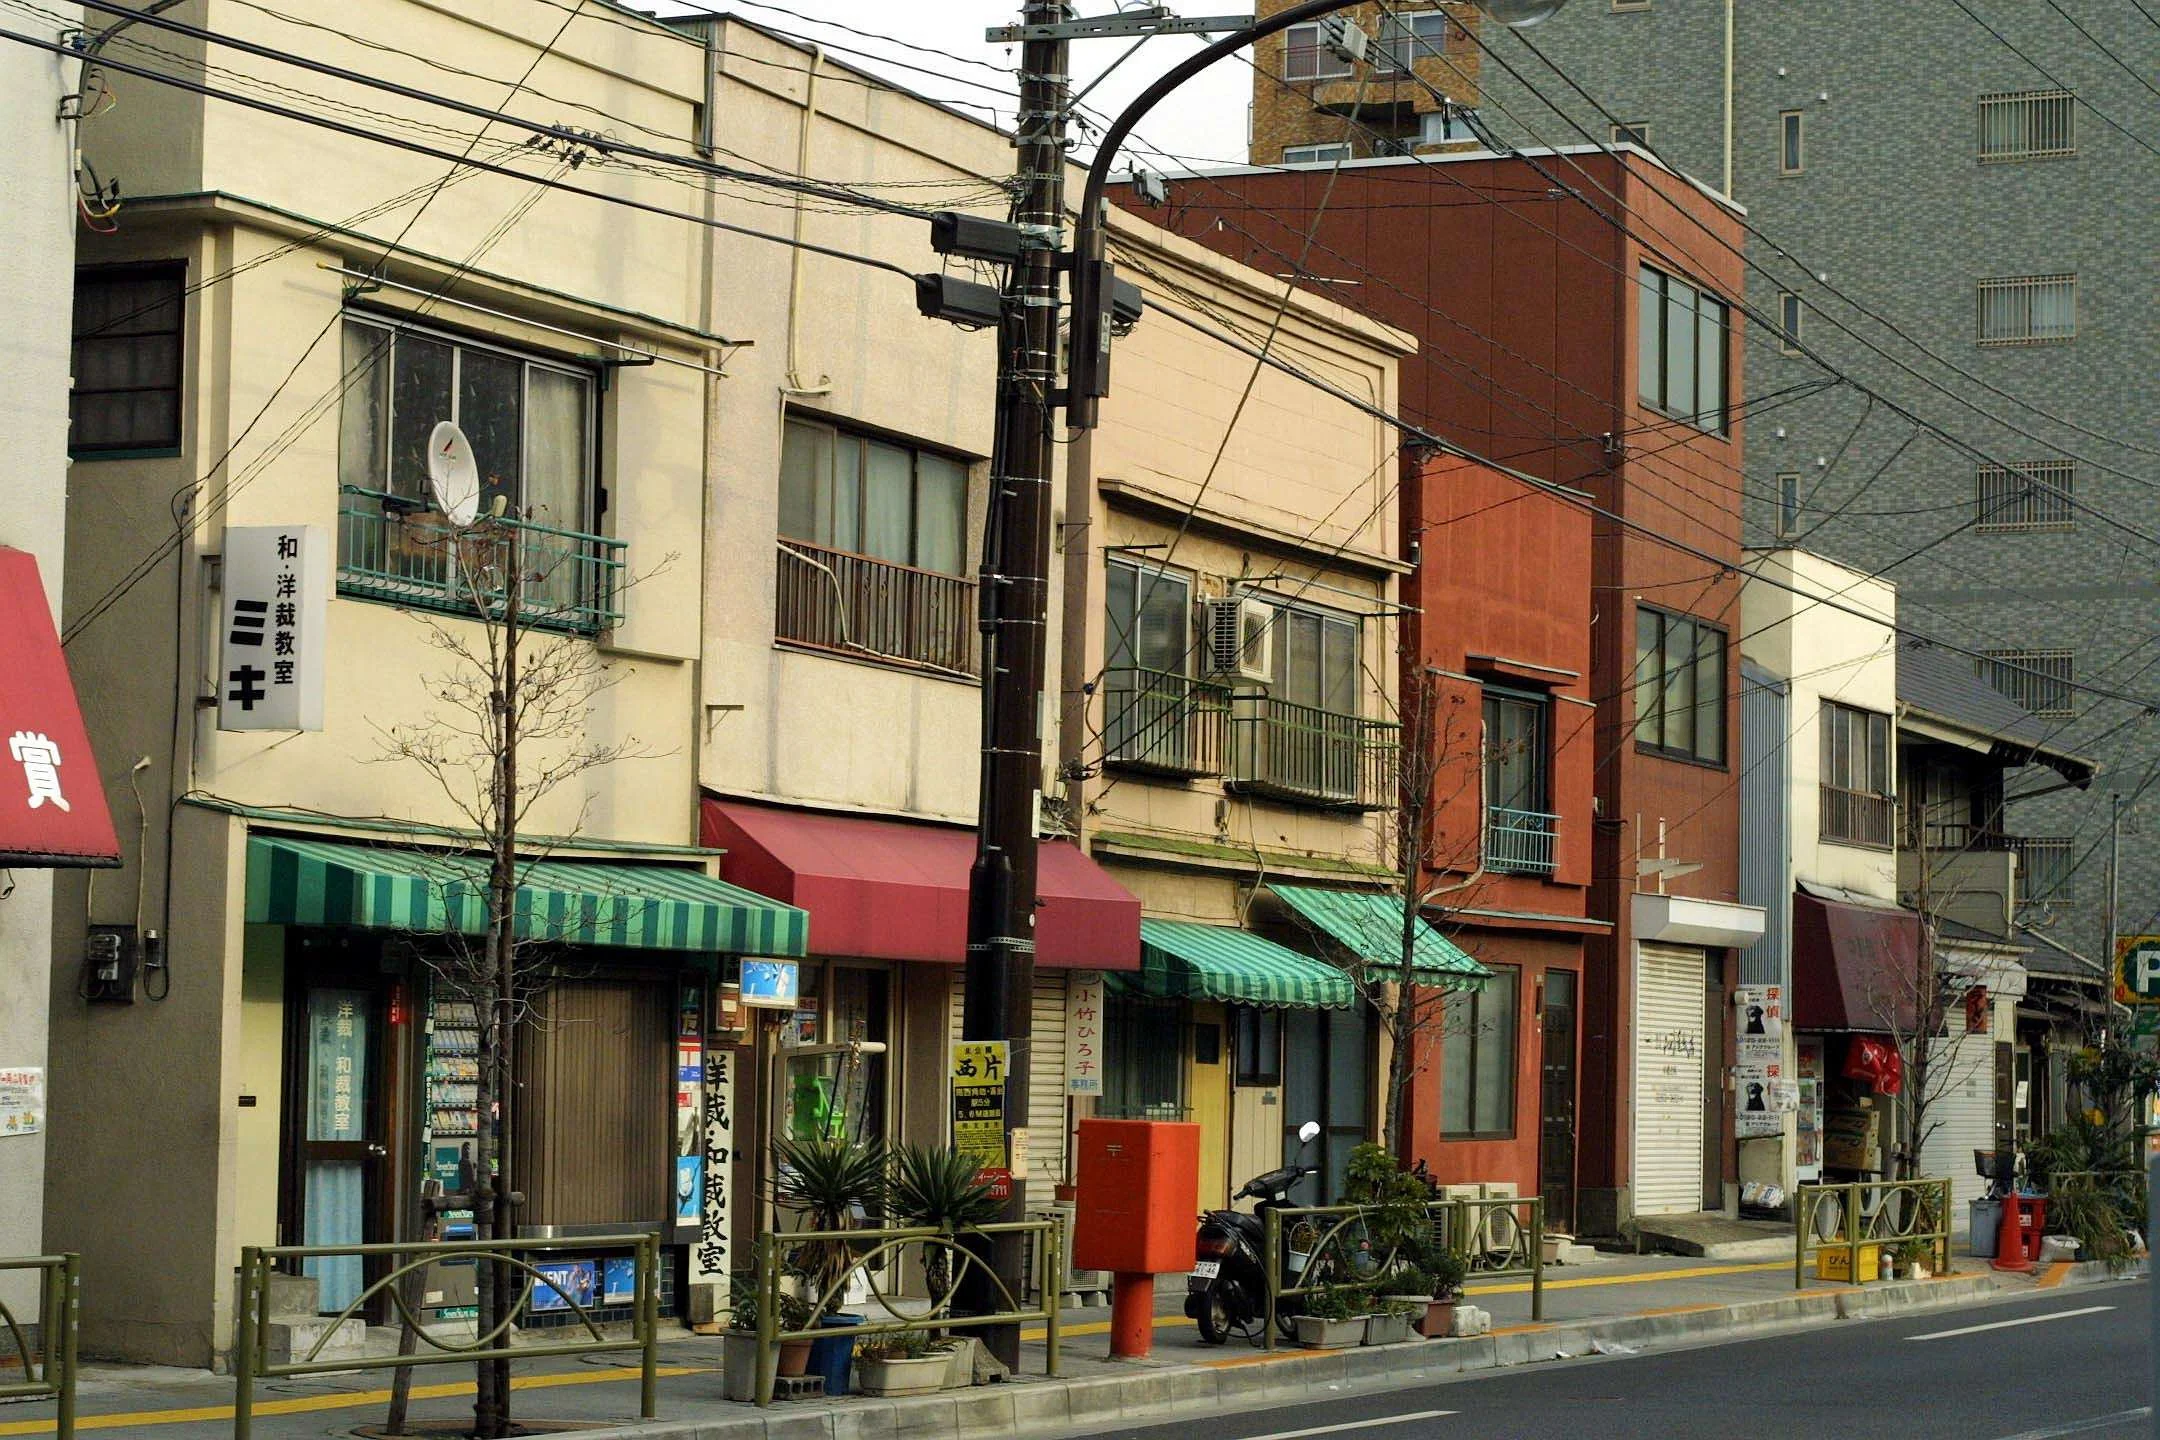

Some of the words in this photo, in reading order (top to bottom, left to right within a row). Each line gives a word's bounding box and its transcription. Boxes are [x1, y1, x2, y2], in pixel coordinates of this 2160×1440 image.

[274, 535, 298, 685] 和・洋裁教室
[228, 599, 269, 711] ミキ
[2136, 950, 2160, 993] P
[955, 1054, 1002, 1080] 西片
[1073, 989, 1097, 1075] 小竹ひろ子
